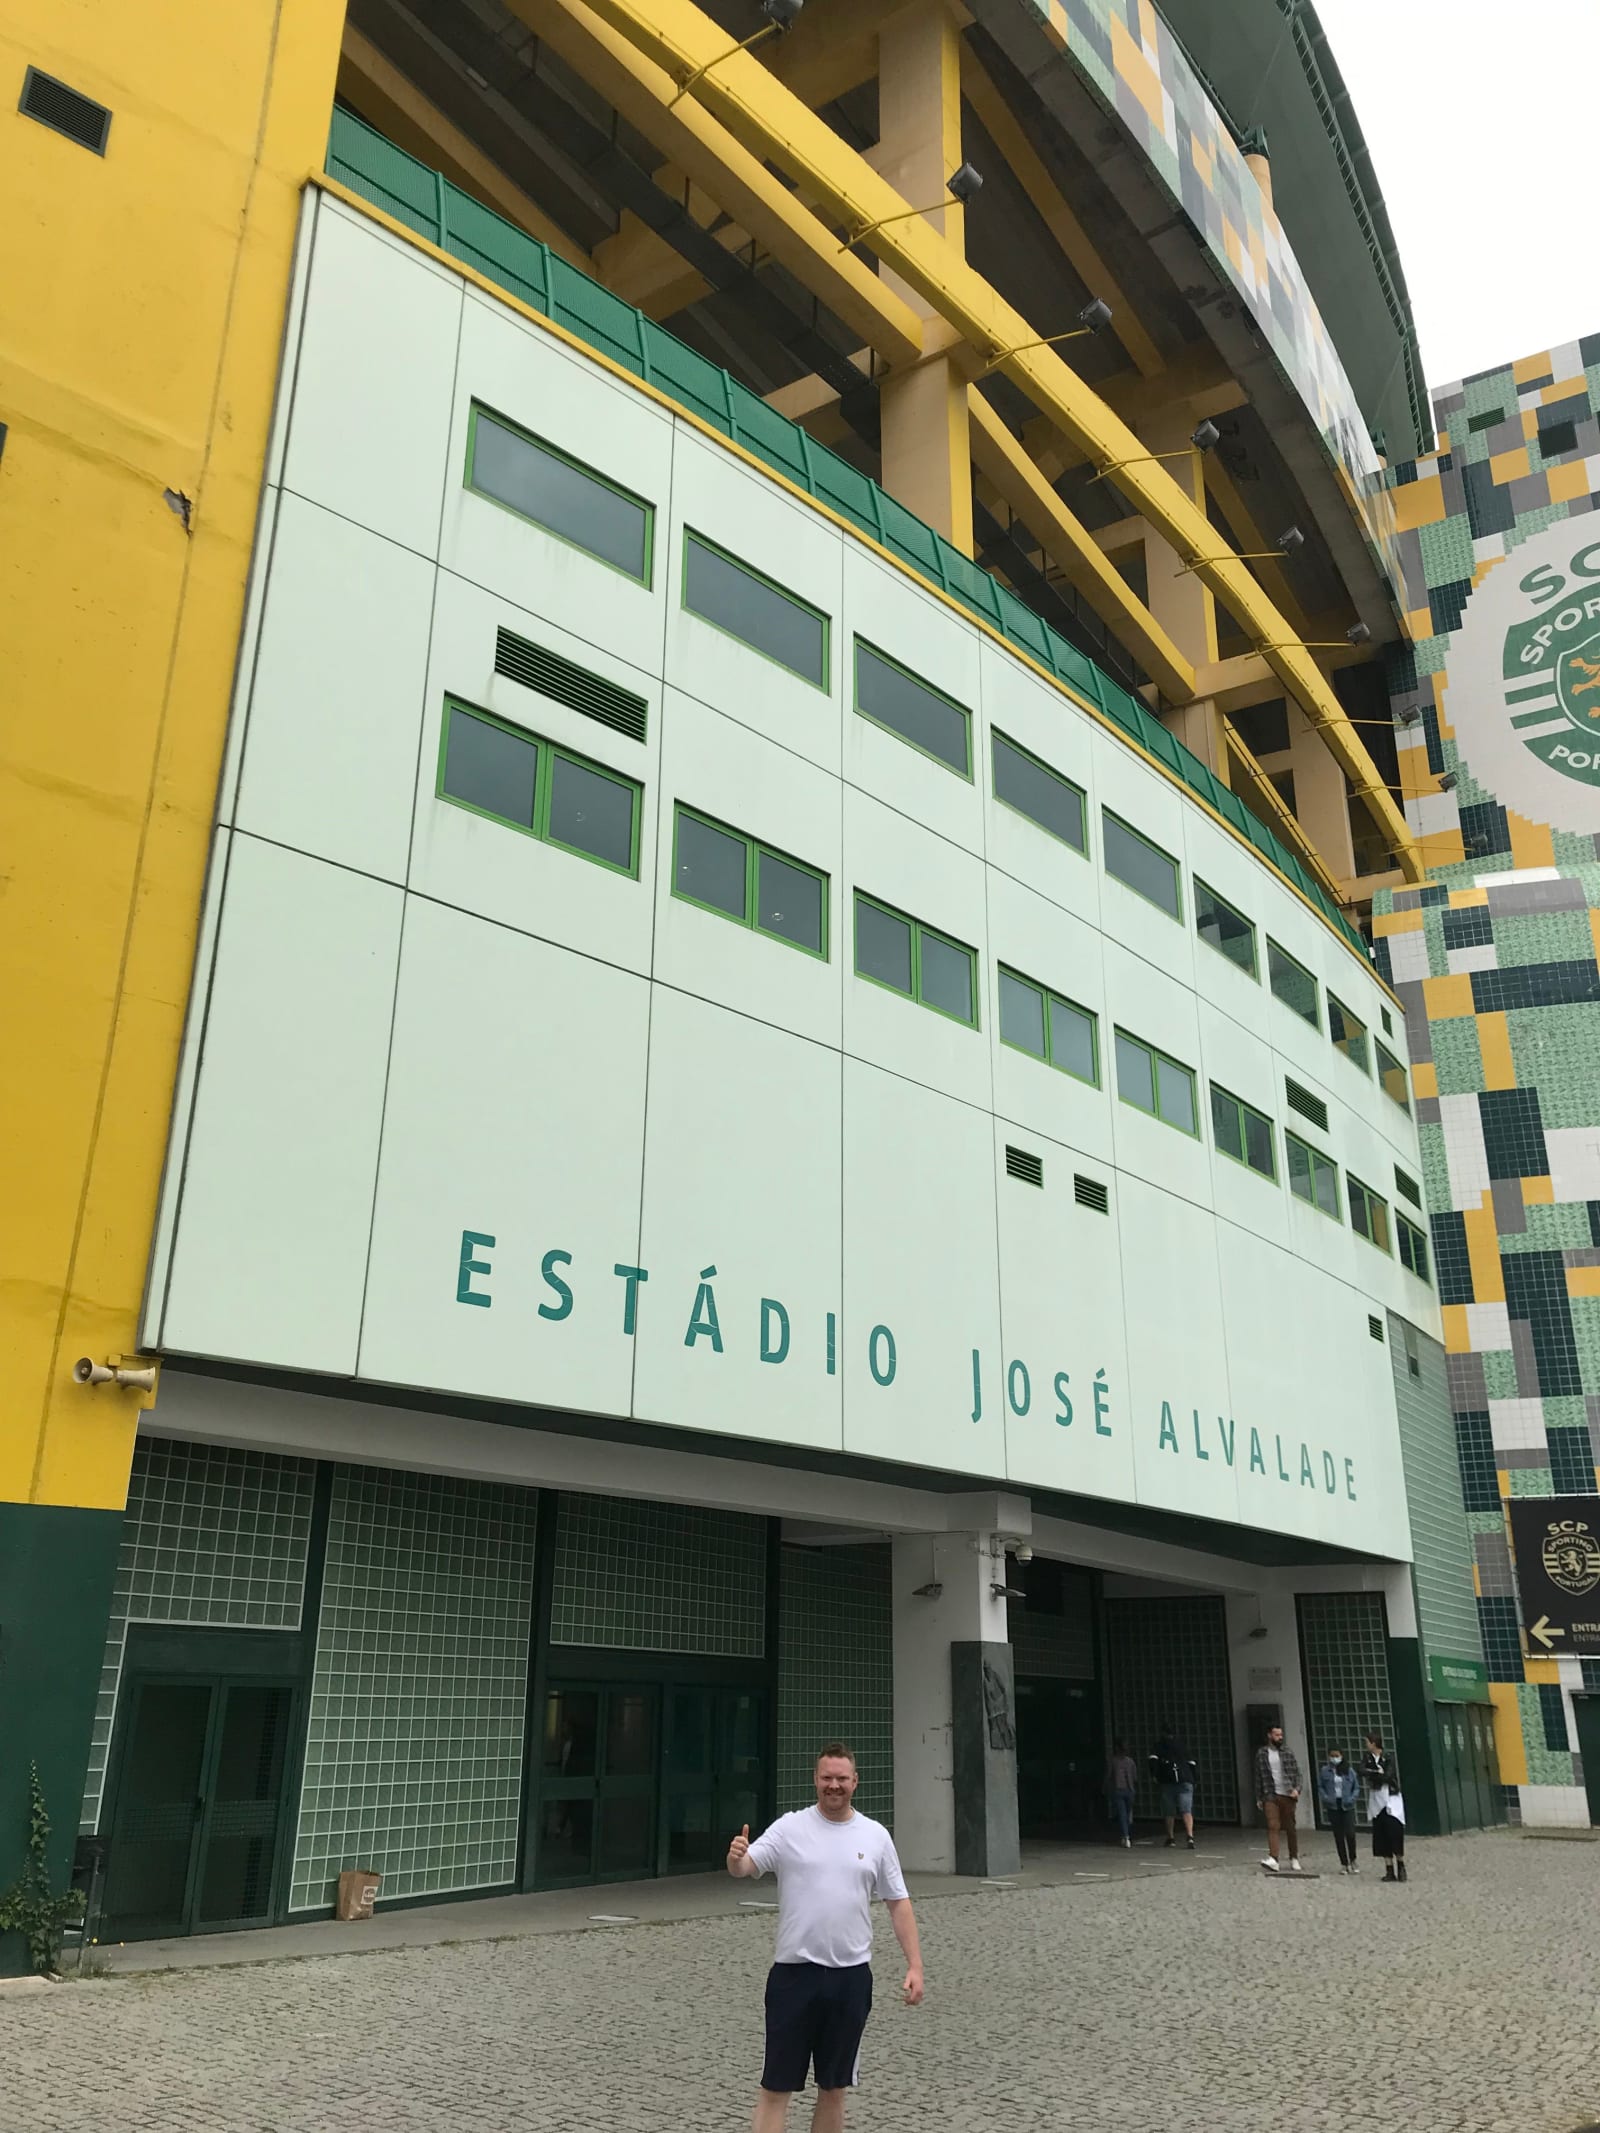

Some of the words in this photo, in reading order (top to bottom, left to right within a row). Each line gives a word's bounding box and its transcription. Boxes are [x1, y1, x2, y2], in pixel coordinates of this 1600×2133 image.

[456, 1229, 897, 1387] ESTÁDIO
[971, 1348, 1112, 1438] JOSÉ
[1158, 1400, 1357, 1502] ALVALADE
[1547, 1520, 1589, 1535] SCP
